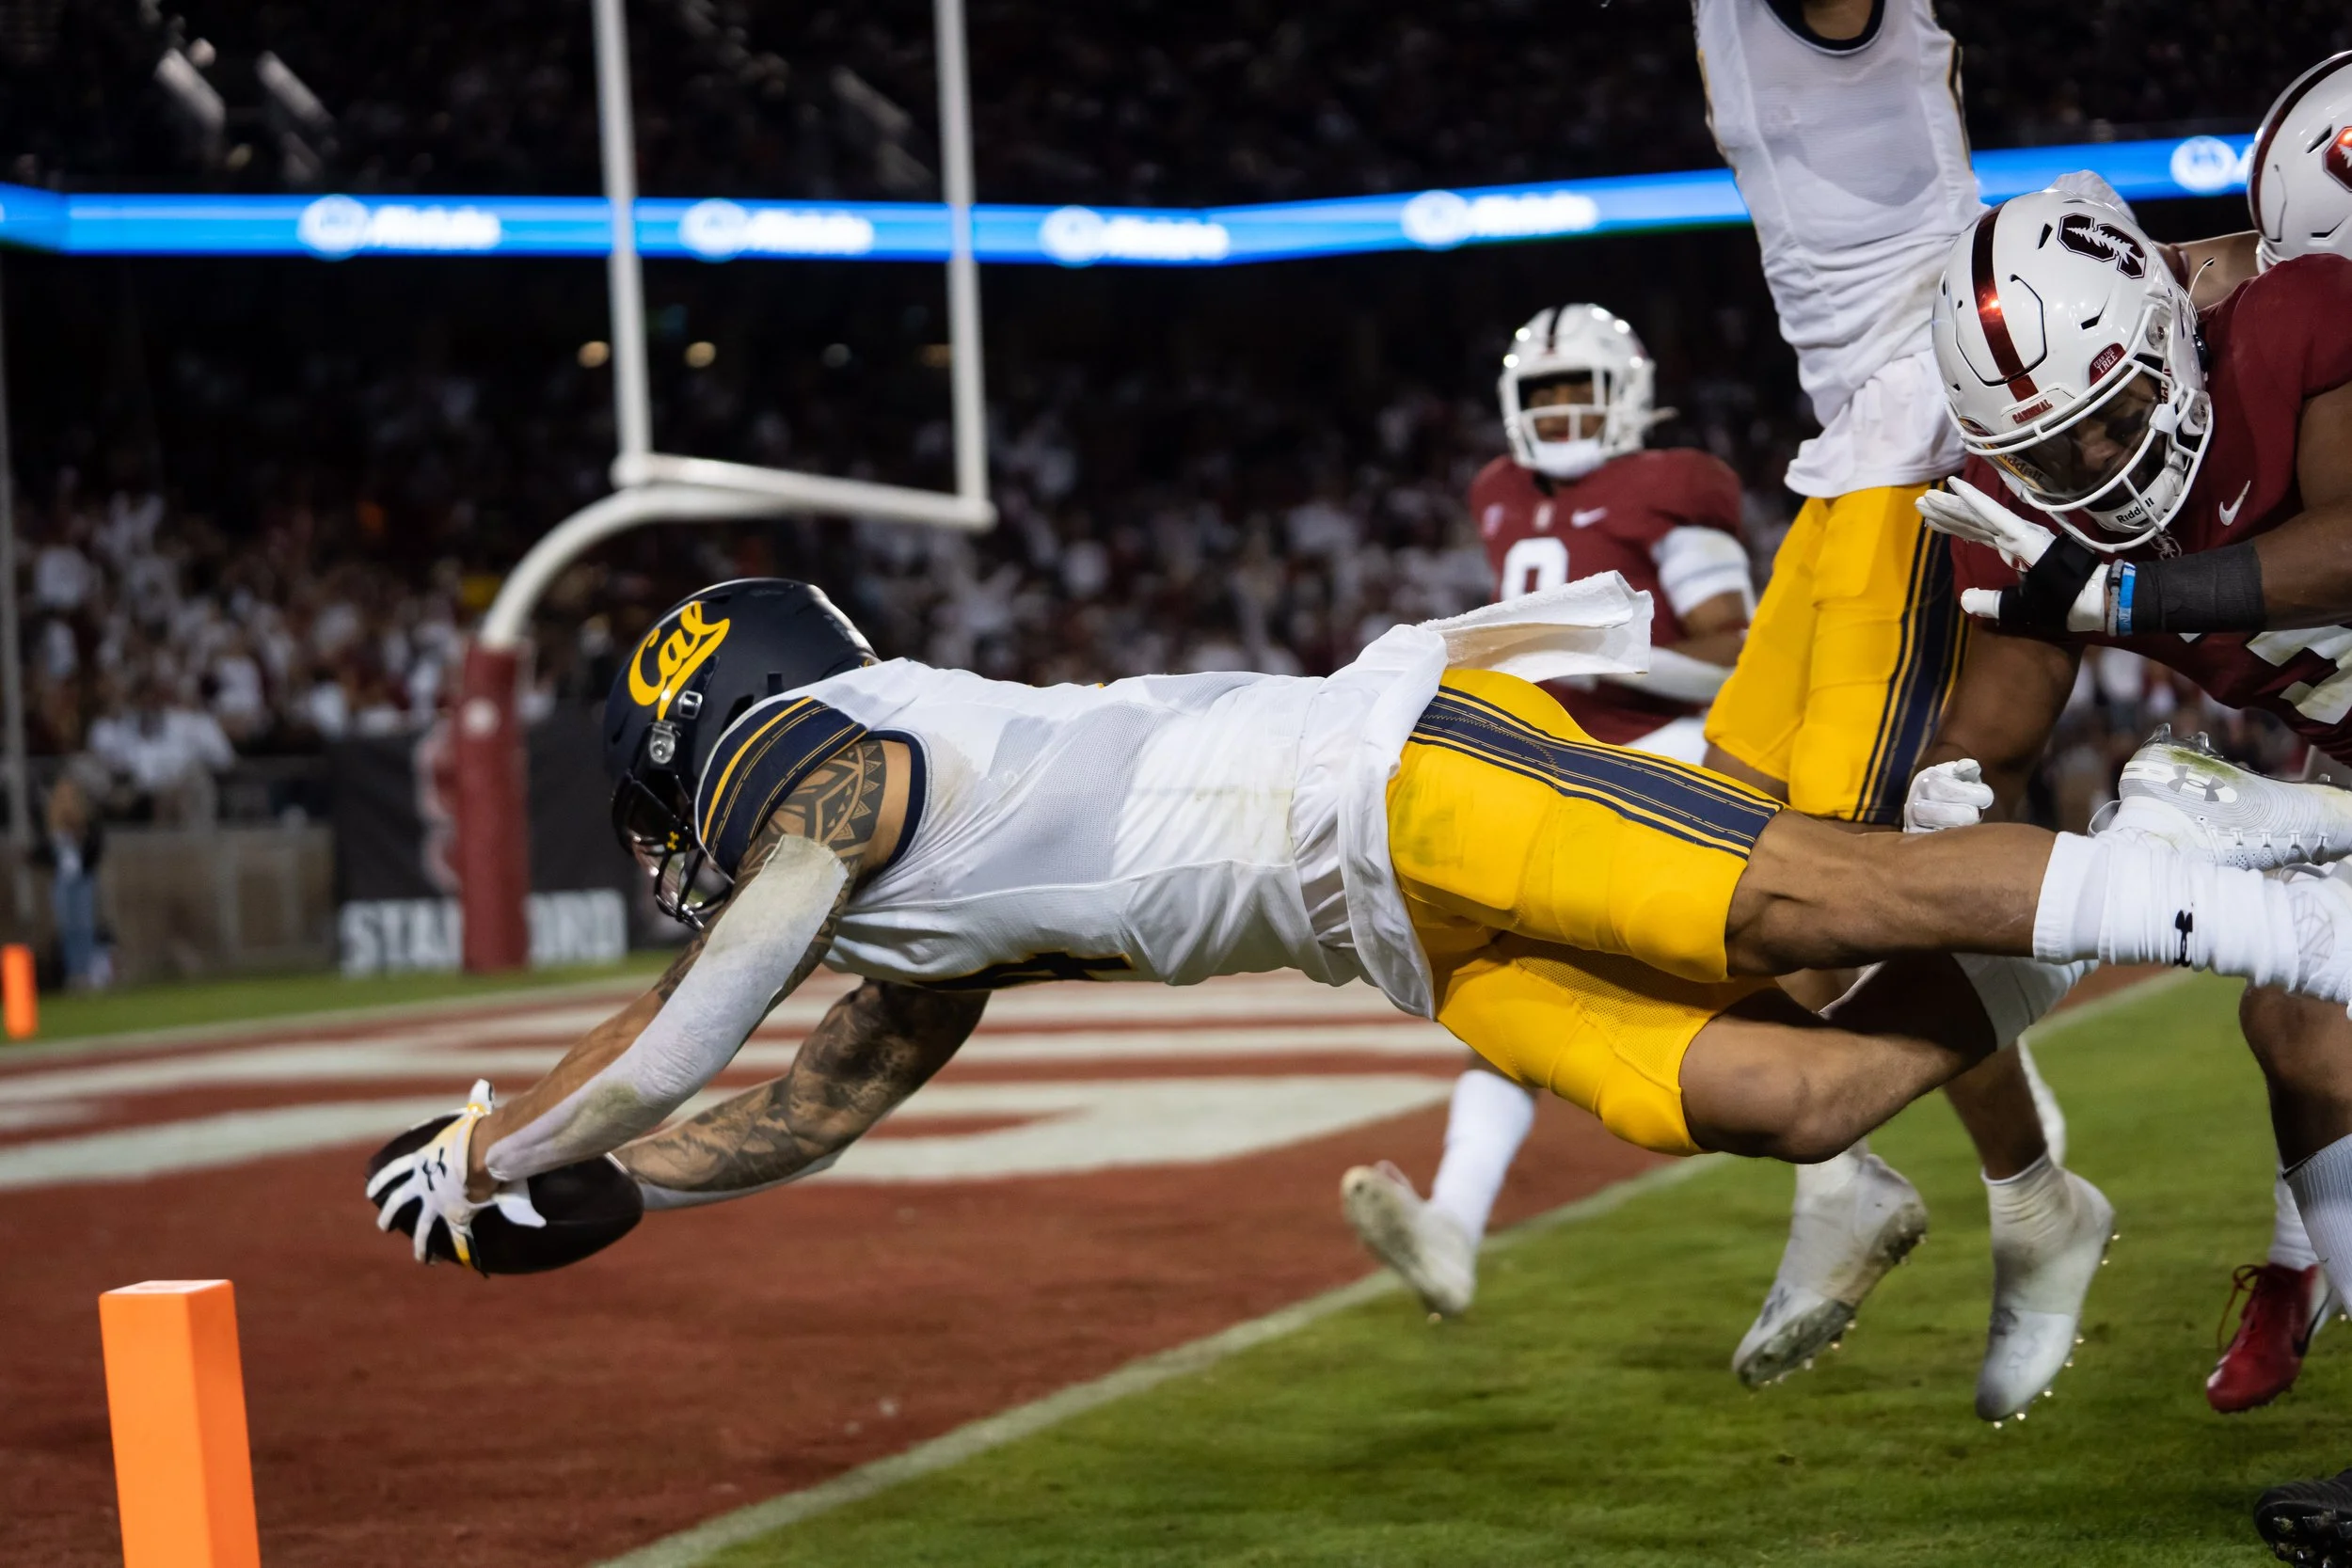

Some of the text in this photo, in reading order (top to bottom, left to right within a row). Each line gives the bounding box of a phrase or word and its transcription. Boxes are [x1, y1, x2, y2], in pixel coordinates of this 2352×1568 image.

[2093, 347, 2115, 368] FEAR THE
[2096, 352, 2119, 374] TREE
[2115, 497, 2154, 523] Riddll
[628, 600, 731, 721] Cal
[340, 889, 628, 974] STAORD
